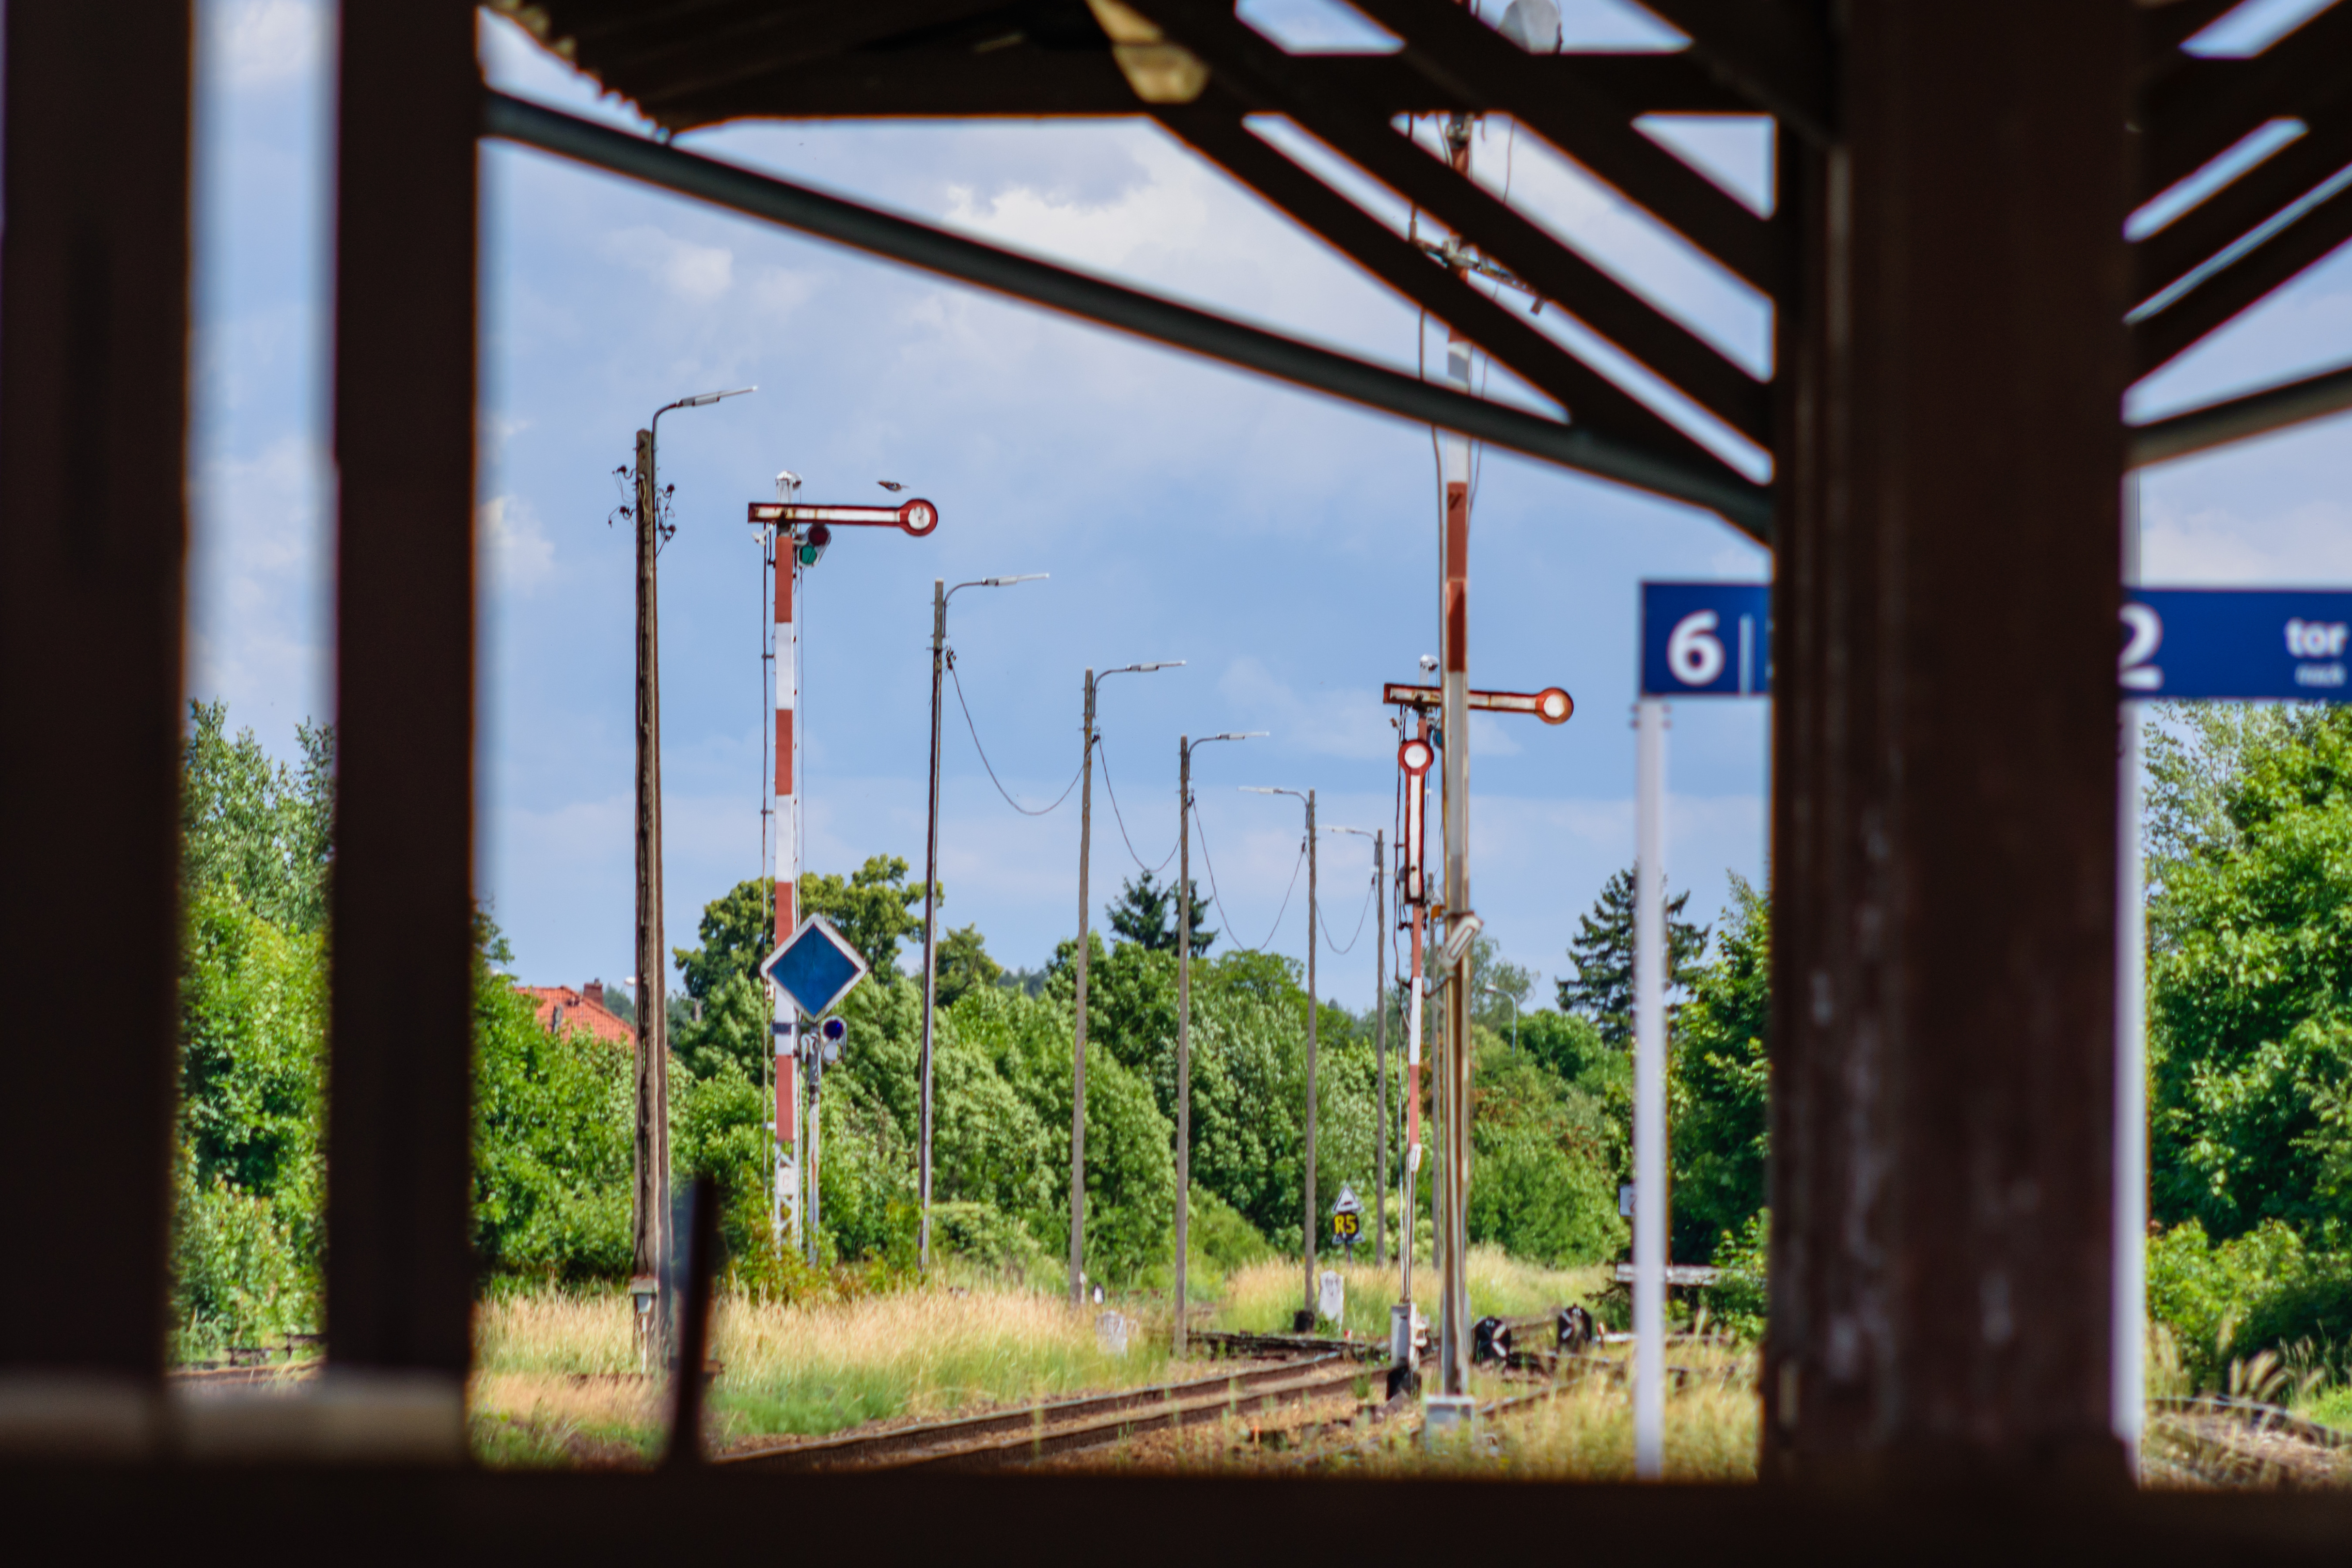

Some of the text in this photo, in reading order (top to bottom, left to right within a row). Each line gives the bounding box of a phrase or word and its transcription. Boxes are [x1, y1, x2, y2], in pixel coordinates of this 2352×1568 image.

[1666, 609, 1726, 687] 6
[2118, 603, 2164, 690] 2
[2284, 618, 2348, 657] tor
[1334, 1214, 1356, 1234] R5
